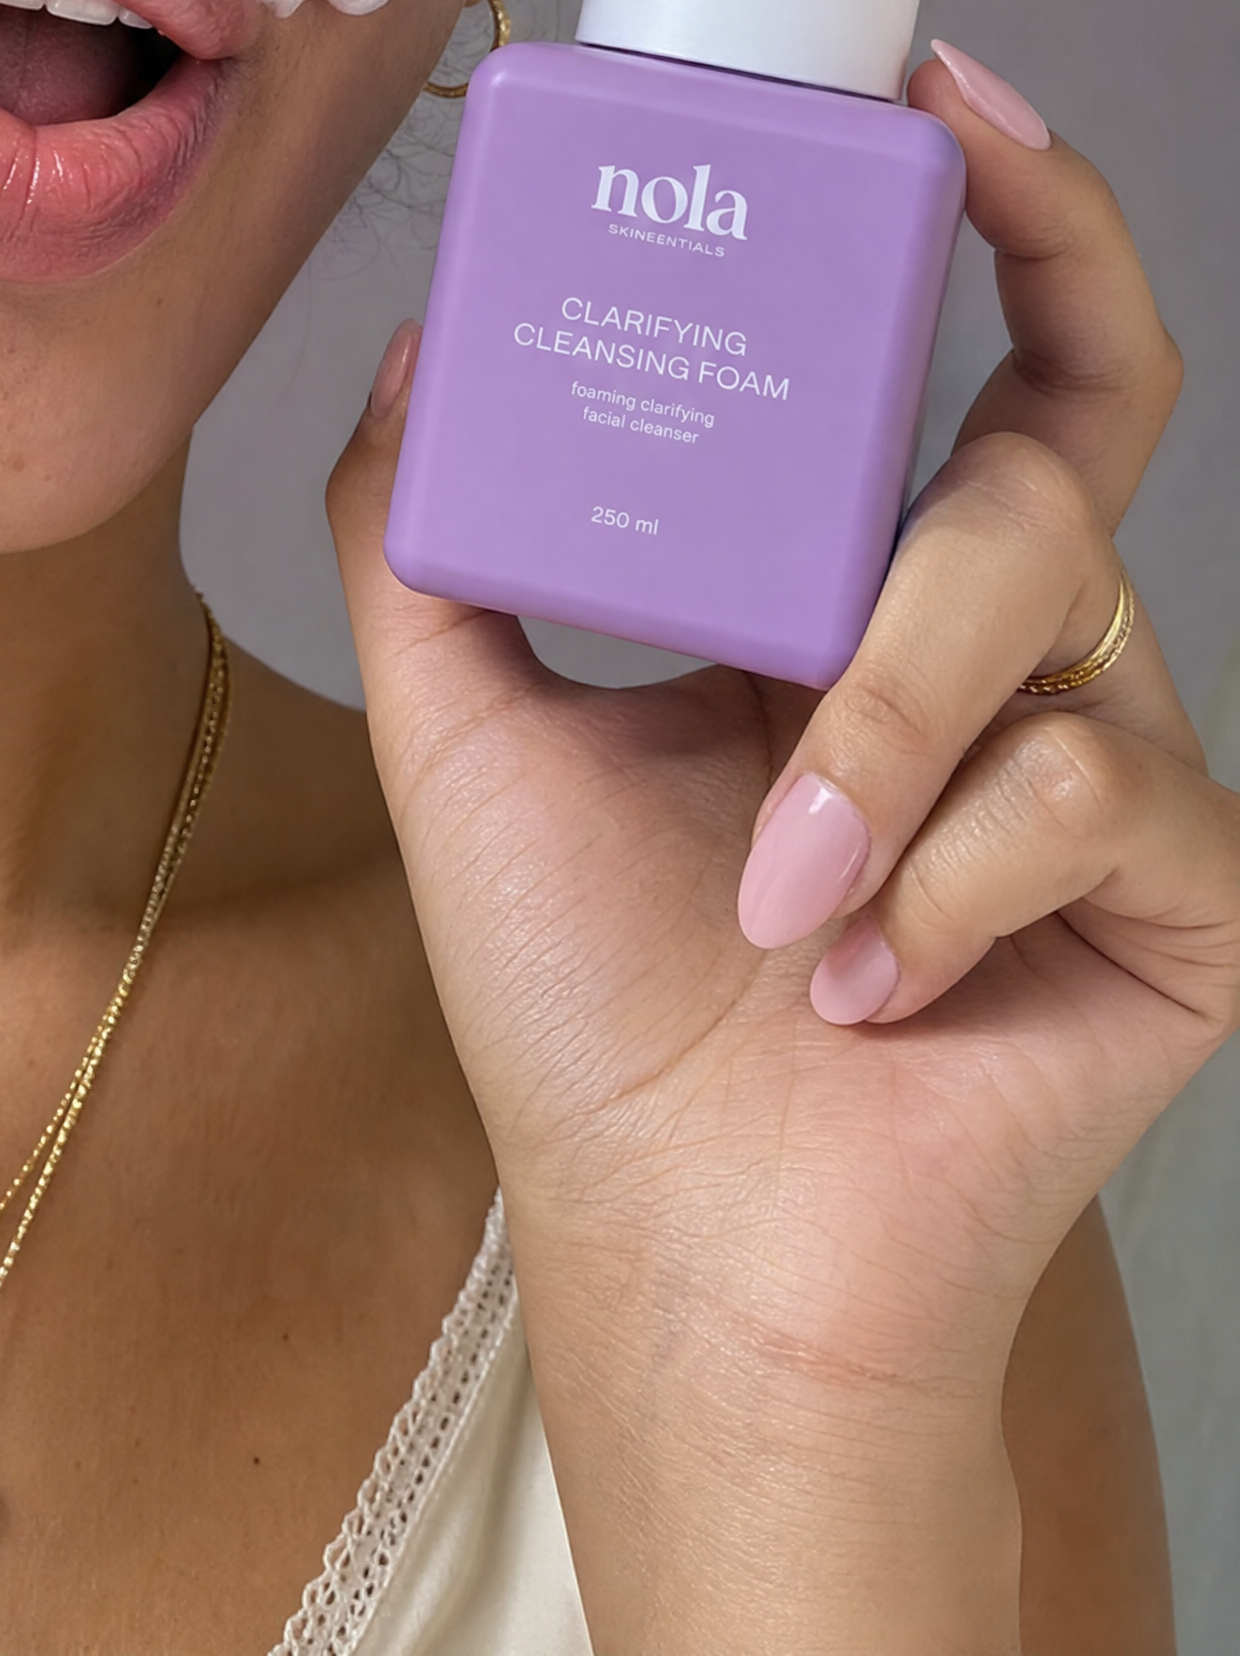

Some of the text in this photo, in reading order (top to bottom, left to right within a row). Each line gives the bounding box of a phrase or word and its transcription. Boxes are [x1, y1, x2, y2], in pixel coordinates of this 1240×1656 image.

[591, 164, 748, 241] nola
[608, 224, 725, 258] SKINEENTIALS
[561, 297, 747, 356] CLARIFYING
[513, 323, 790, 401] CLEANSING FOAM
[571, 381, 715, 429] foaming clarifying
[583, 406, 700, 444] facial cleanser
[590, 506, 660, 535] 250 ml
